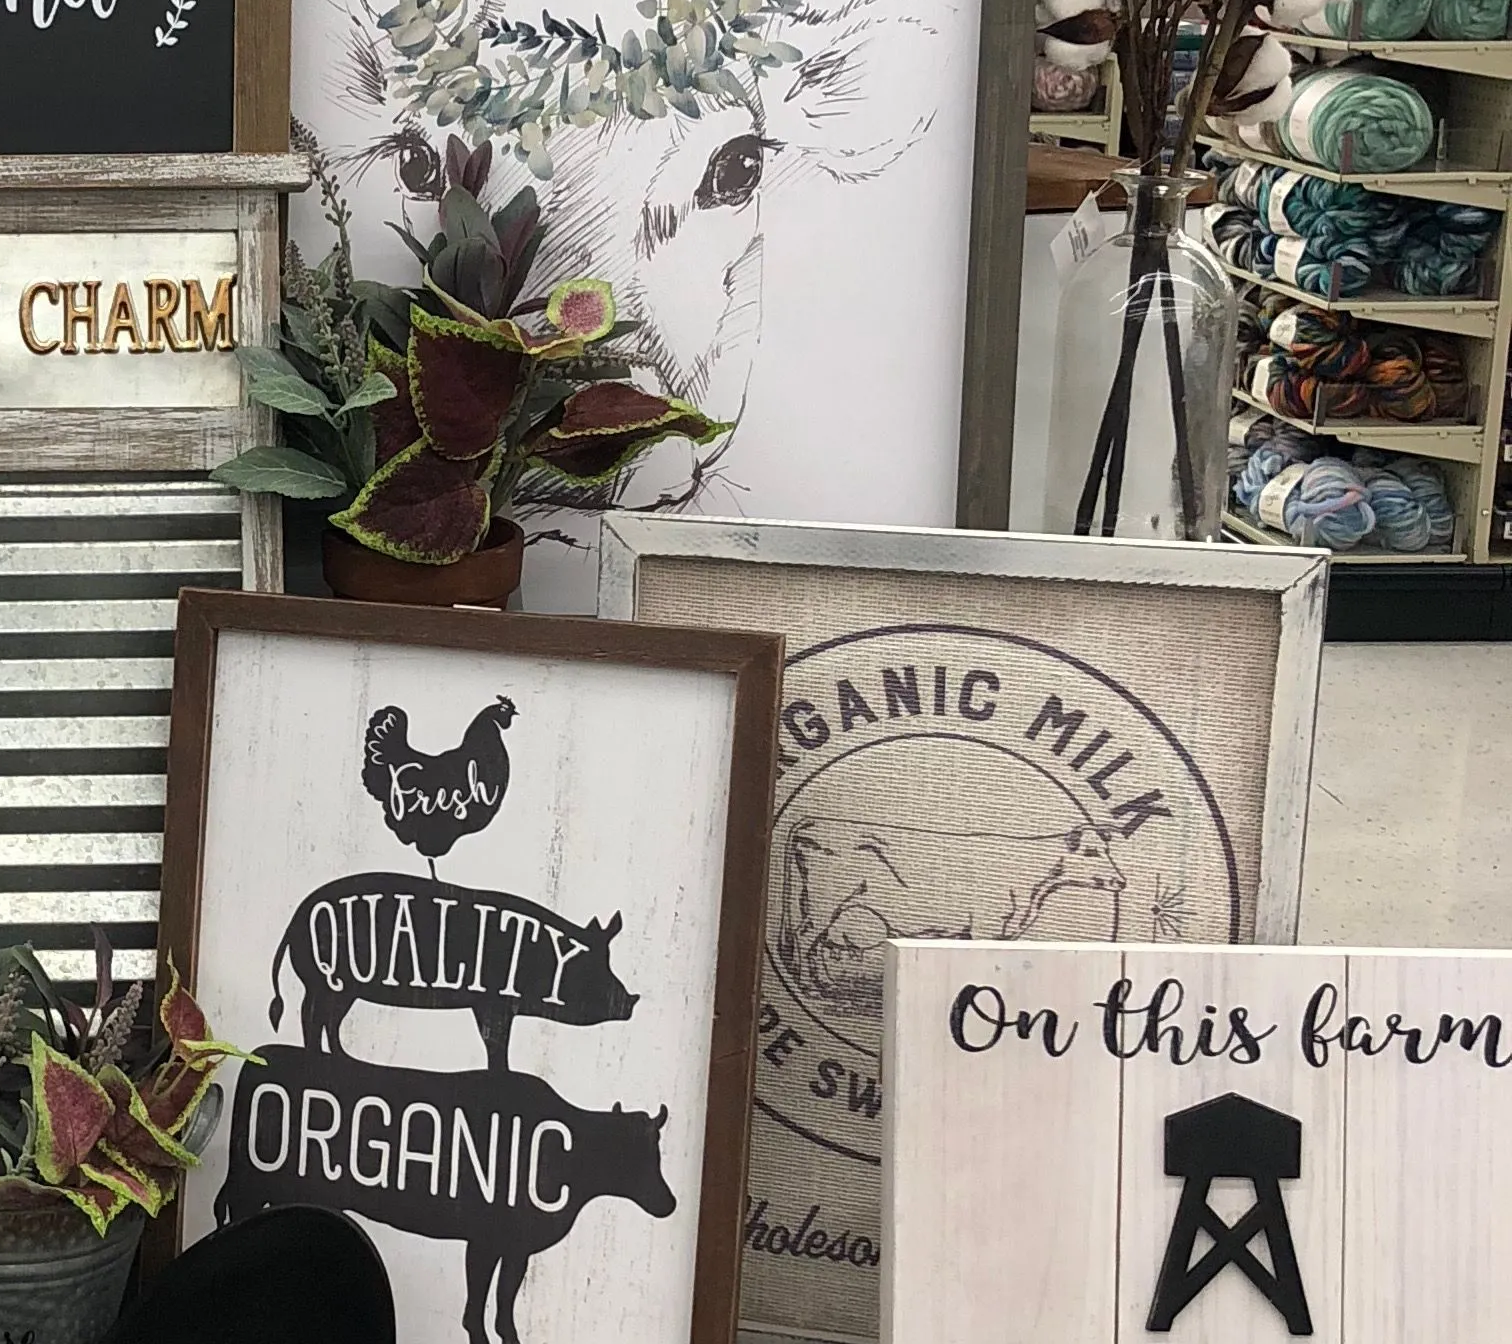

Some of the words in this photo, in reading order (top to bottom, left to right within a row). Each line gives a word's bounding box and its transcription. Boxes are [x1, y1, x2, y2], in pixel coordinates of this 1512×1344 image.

[18, 272, 240, 357] CHARM
[388, 758, 499, 821] Fresh
[776, 664, 1000, 780] GANIC
[1025, 694, 1173, 839] MILK
[308, 892, 591, 1007] QUALITY
[949, 982, 1078, 1057] On
[1092, 977, 1278, 1066] this
[1300, 982, 1512, 1068] farm
[248, 1081, 573, 1213] ORGANIC
[744, 1196, 880, 1267] holeso
